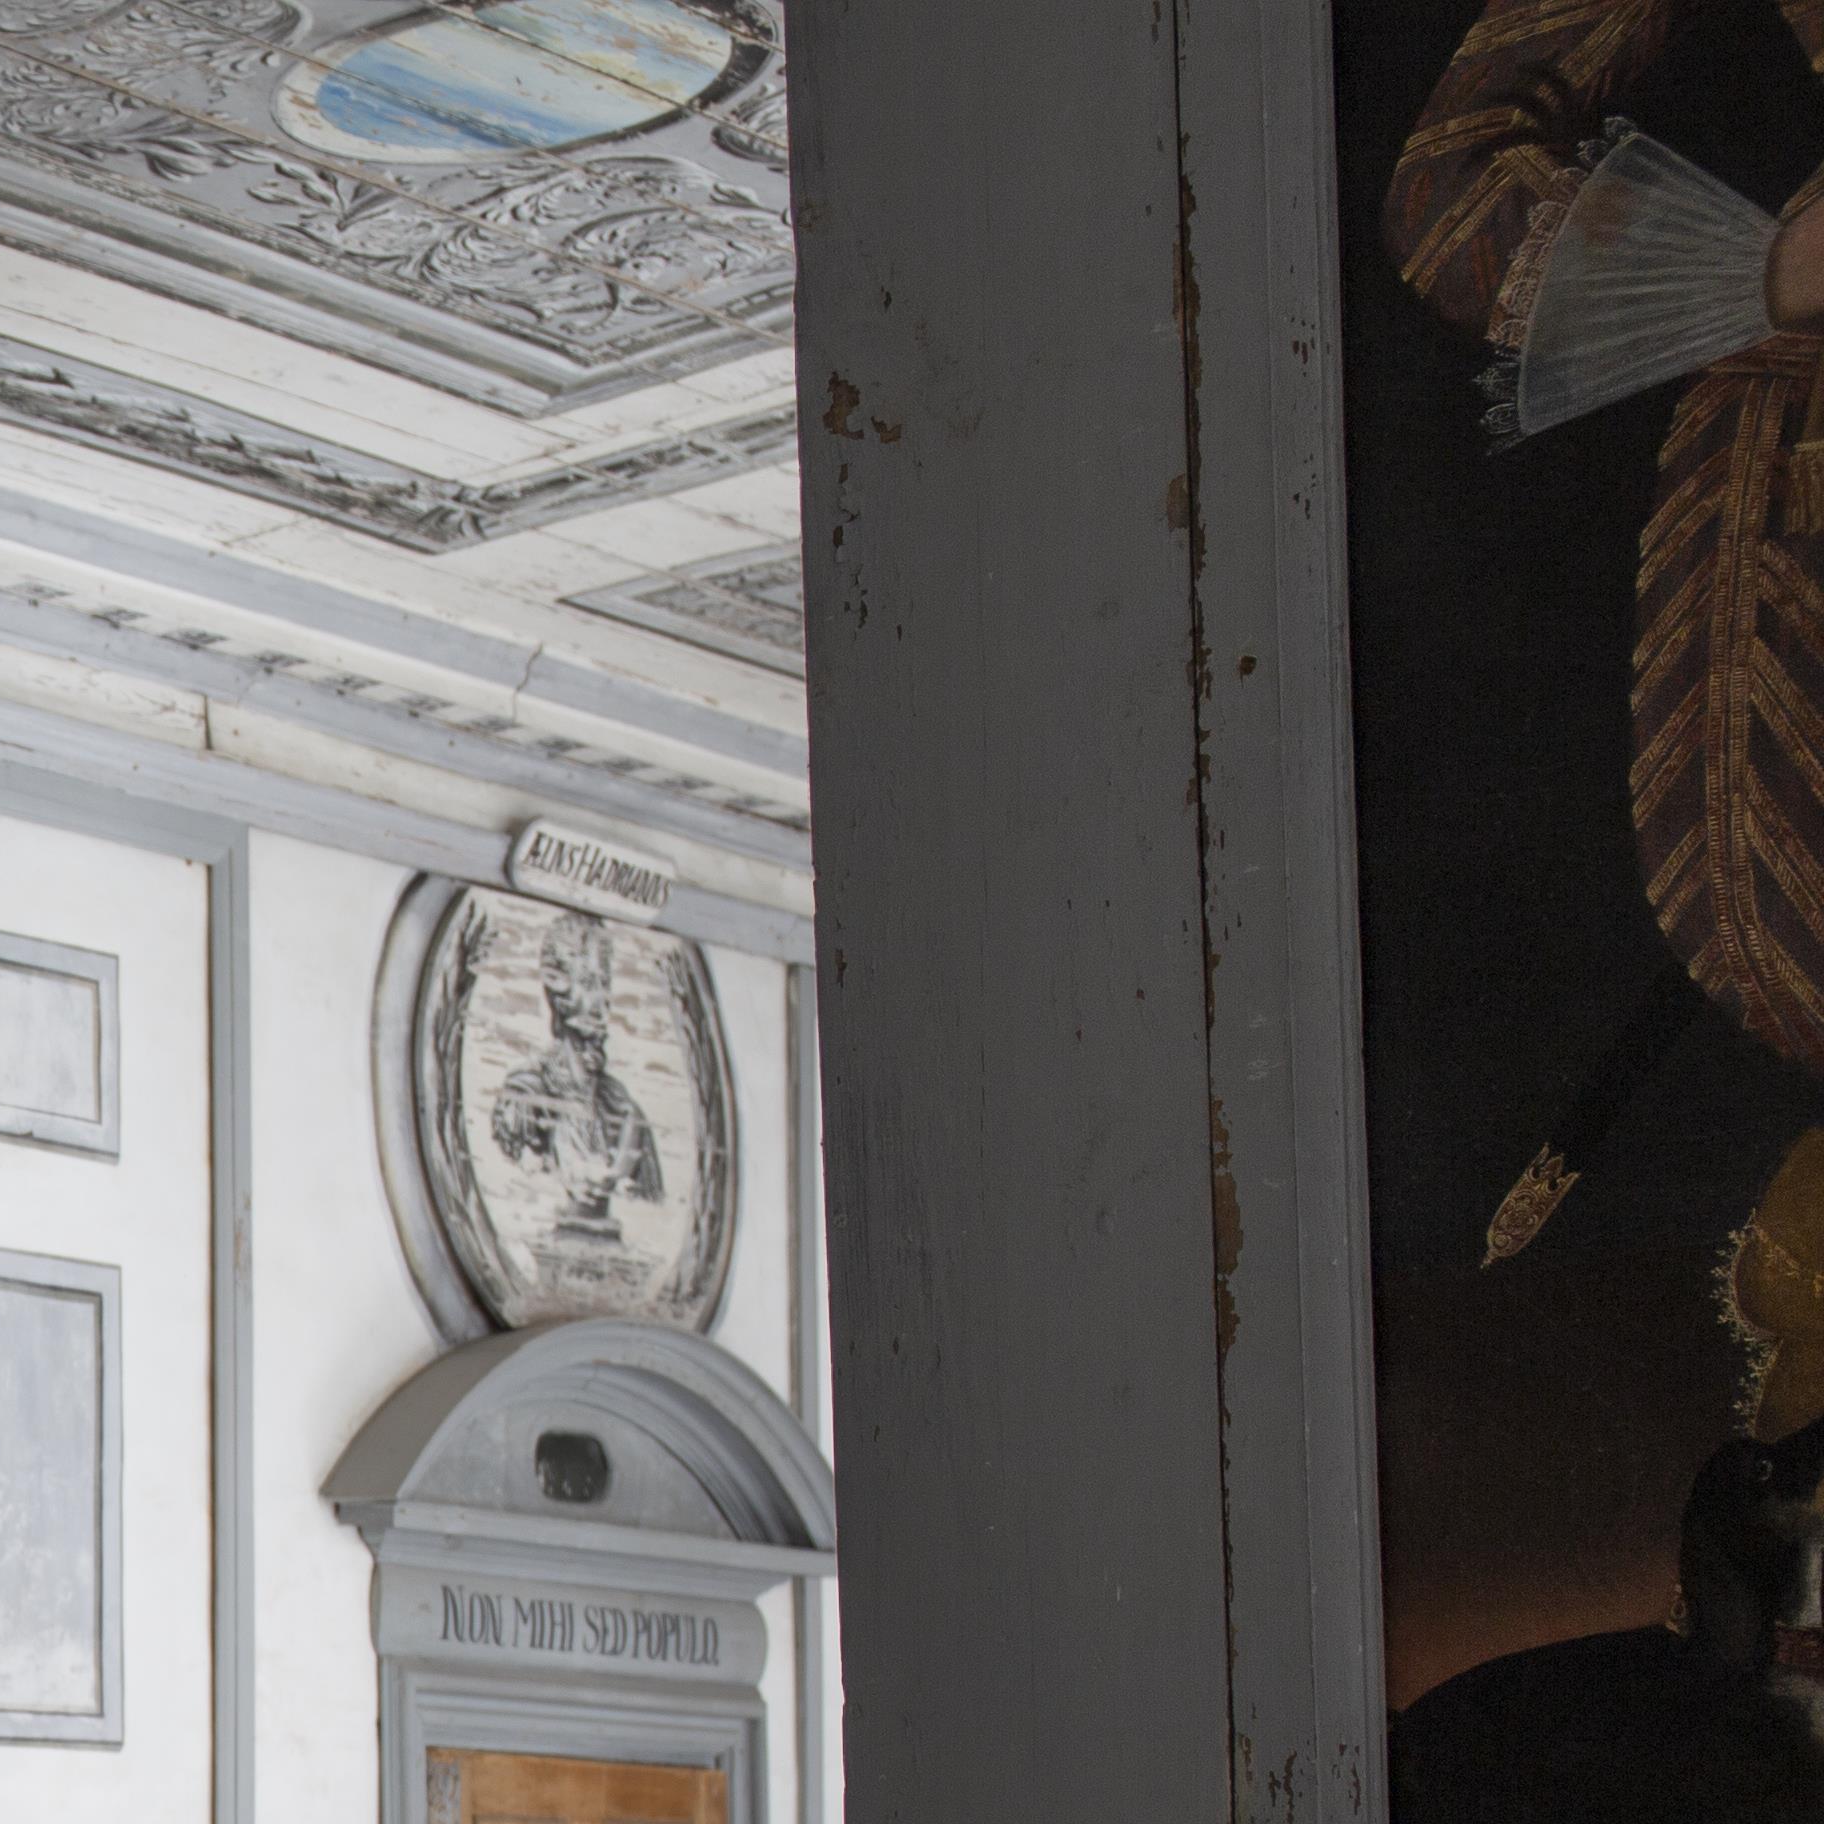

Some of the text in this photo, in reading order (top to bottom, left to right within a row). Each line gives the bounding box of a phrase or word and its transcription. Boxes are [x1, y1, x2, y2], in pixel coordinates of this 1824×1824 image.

[440, 1584, 504, 1647] NON
[511, 1595, 574, 1651] MIHI
[581, 1603, 628, 1657] SED
